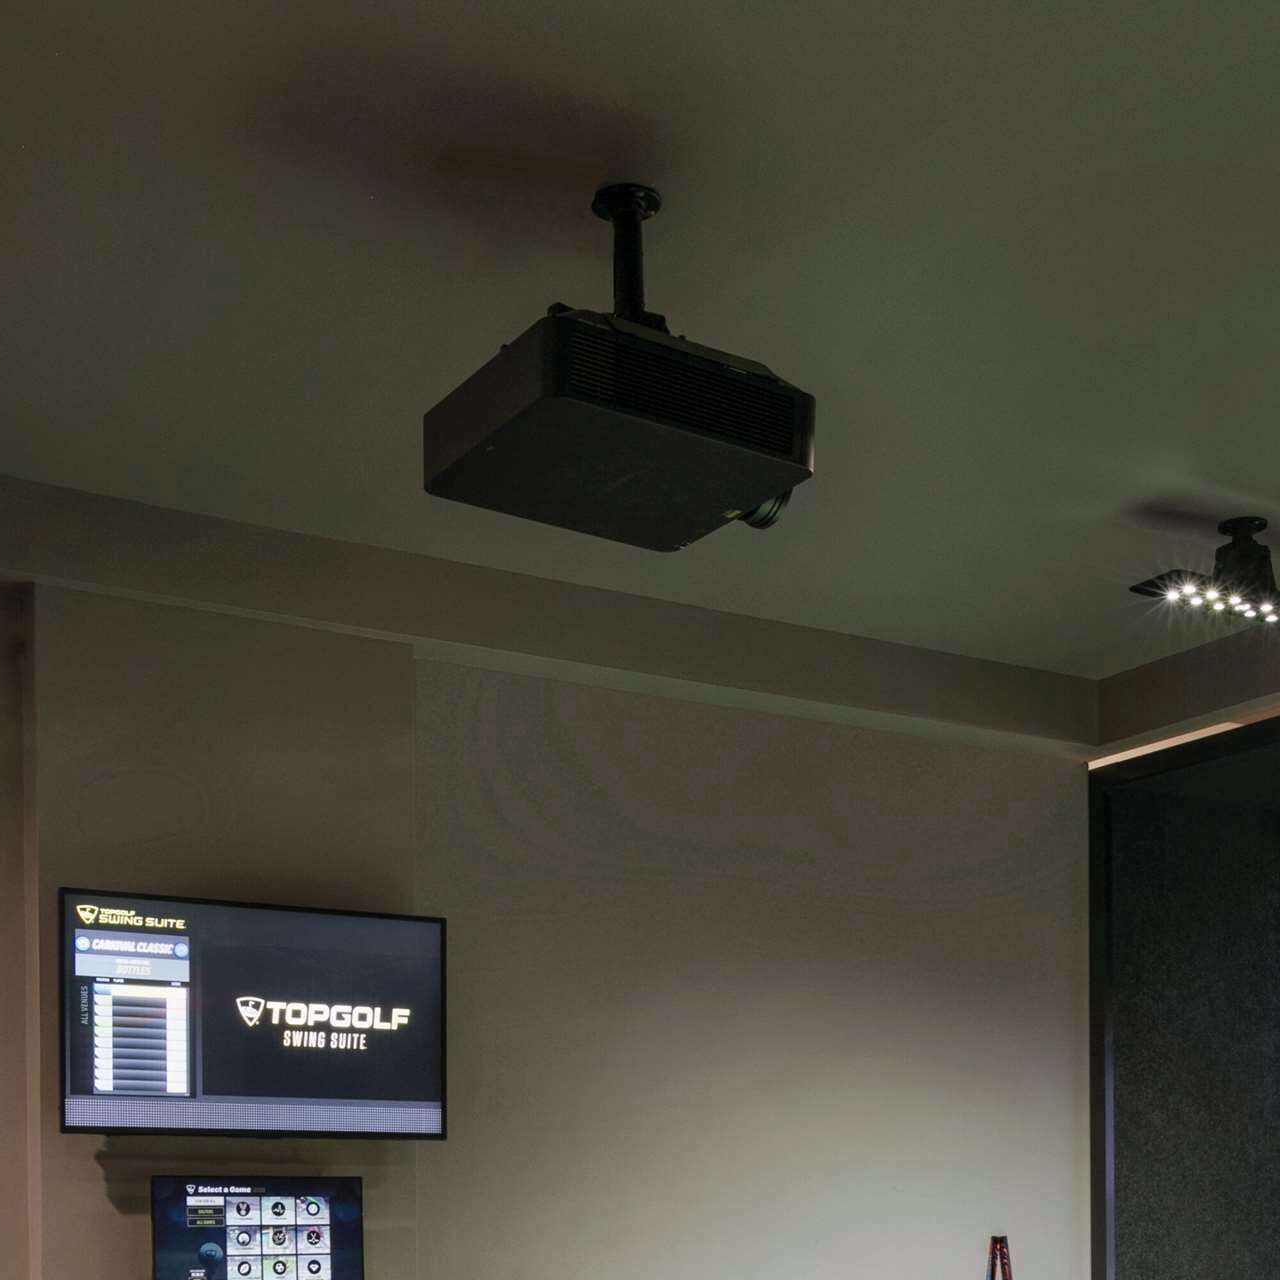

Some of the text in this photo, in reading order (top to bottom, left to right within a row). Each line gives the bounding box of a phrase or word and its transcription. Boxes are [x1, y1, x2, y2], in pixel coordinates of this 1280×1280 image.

[99, 914, 186, 929] SWING SUITE
[137, 942, 174, 955] CLASSIC
[80, 985, 88, 1012] VENUES
[267, 1001, 411, 1030] TOPGOLF
[283, 1030, 368, 1050] SWING SUITE
